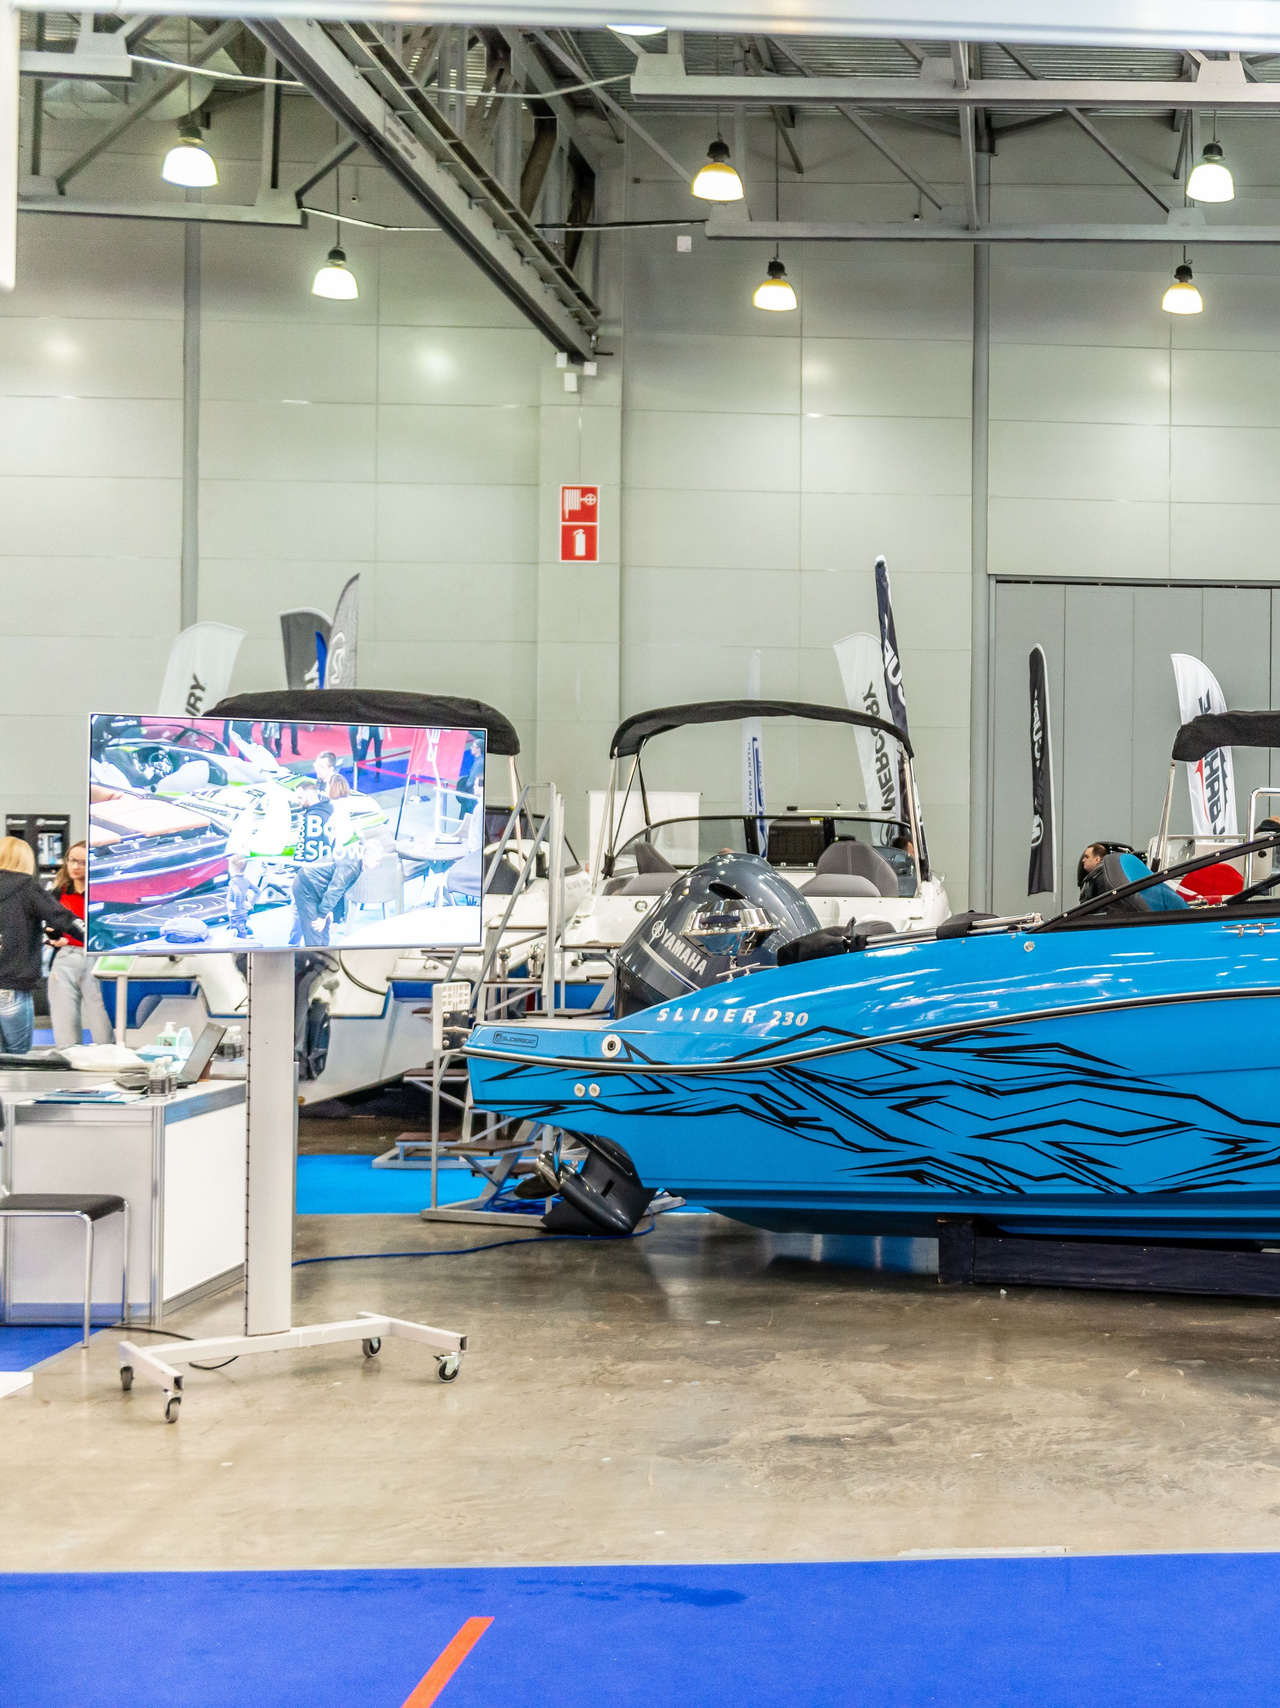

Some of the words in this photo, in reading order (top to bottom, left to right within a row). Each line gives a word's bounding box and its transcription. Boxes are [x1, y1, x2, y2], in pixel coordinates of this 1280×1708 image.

[305, 840, 365, 862] Show
[659, 929, 708, 976] YAMAHA
[656, 1007, 757, 1023] SLIDER
[770, 1010, 809, 1027] 230
